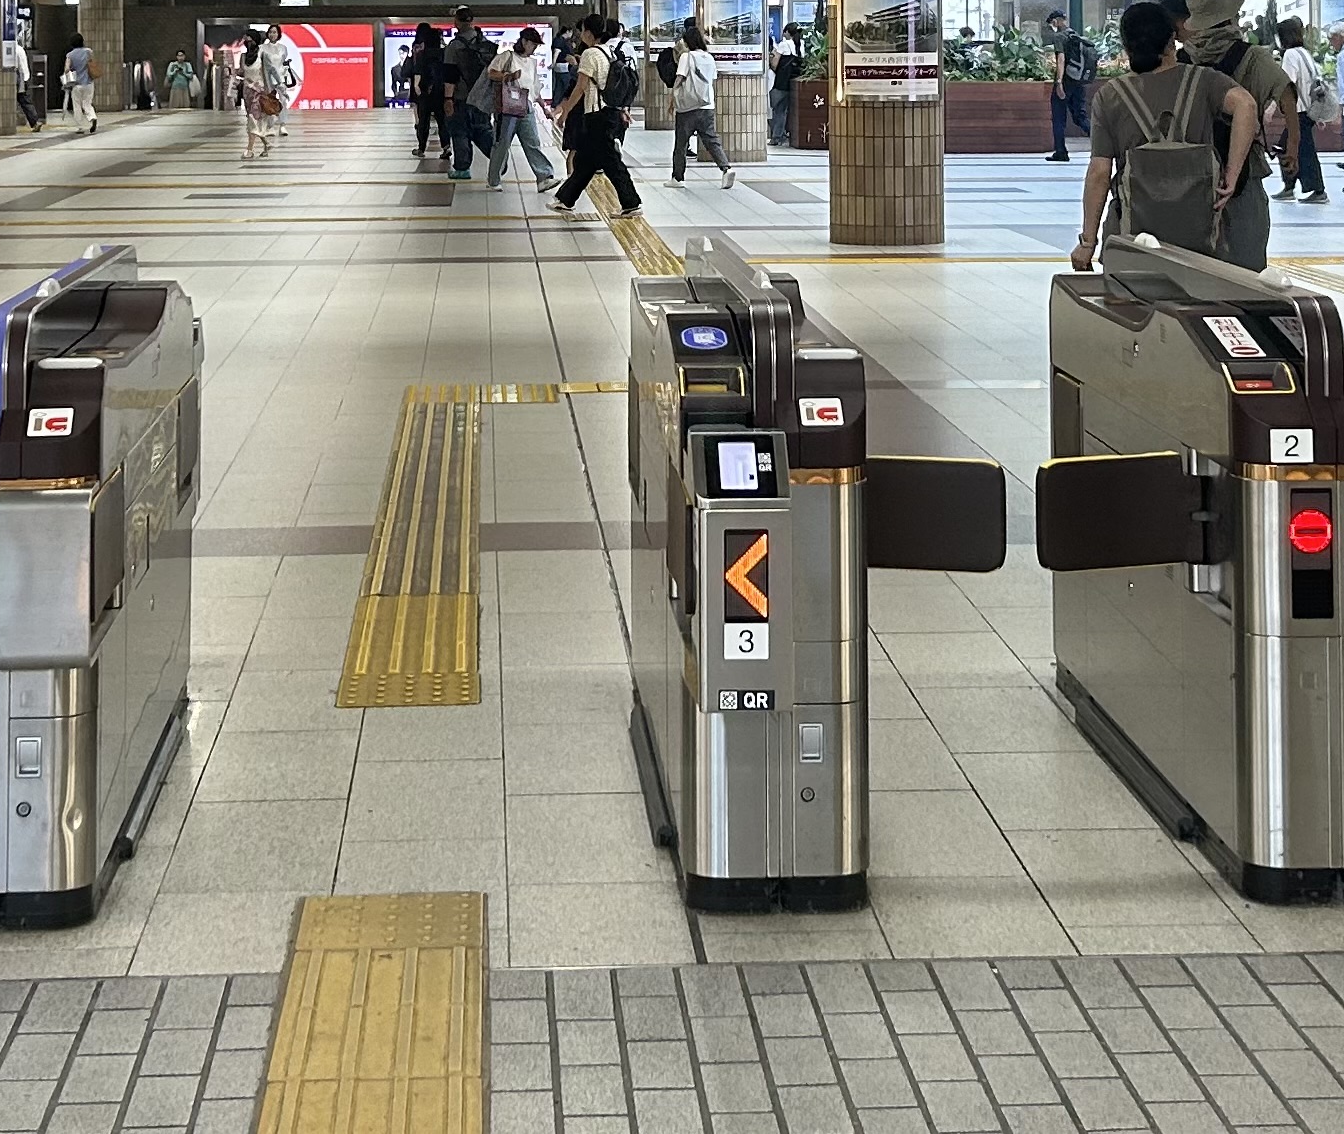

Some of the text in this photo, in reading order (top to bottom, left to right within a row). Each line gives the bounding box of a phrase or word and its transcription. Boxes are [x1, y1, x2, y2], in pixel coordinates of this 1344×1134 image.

[1212, 319, 1254, 346] 利用中止
[1284, 435, 1299, 457] 2
[738, 630, 754, 653] 3
[743, 692, 768, 709] QR
